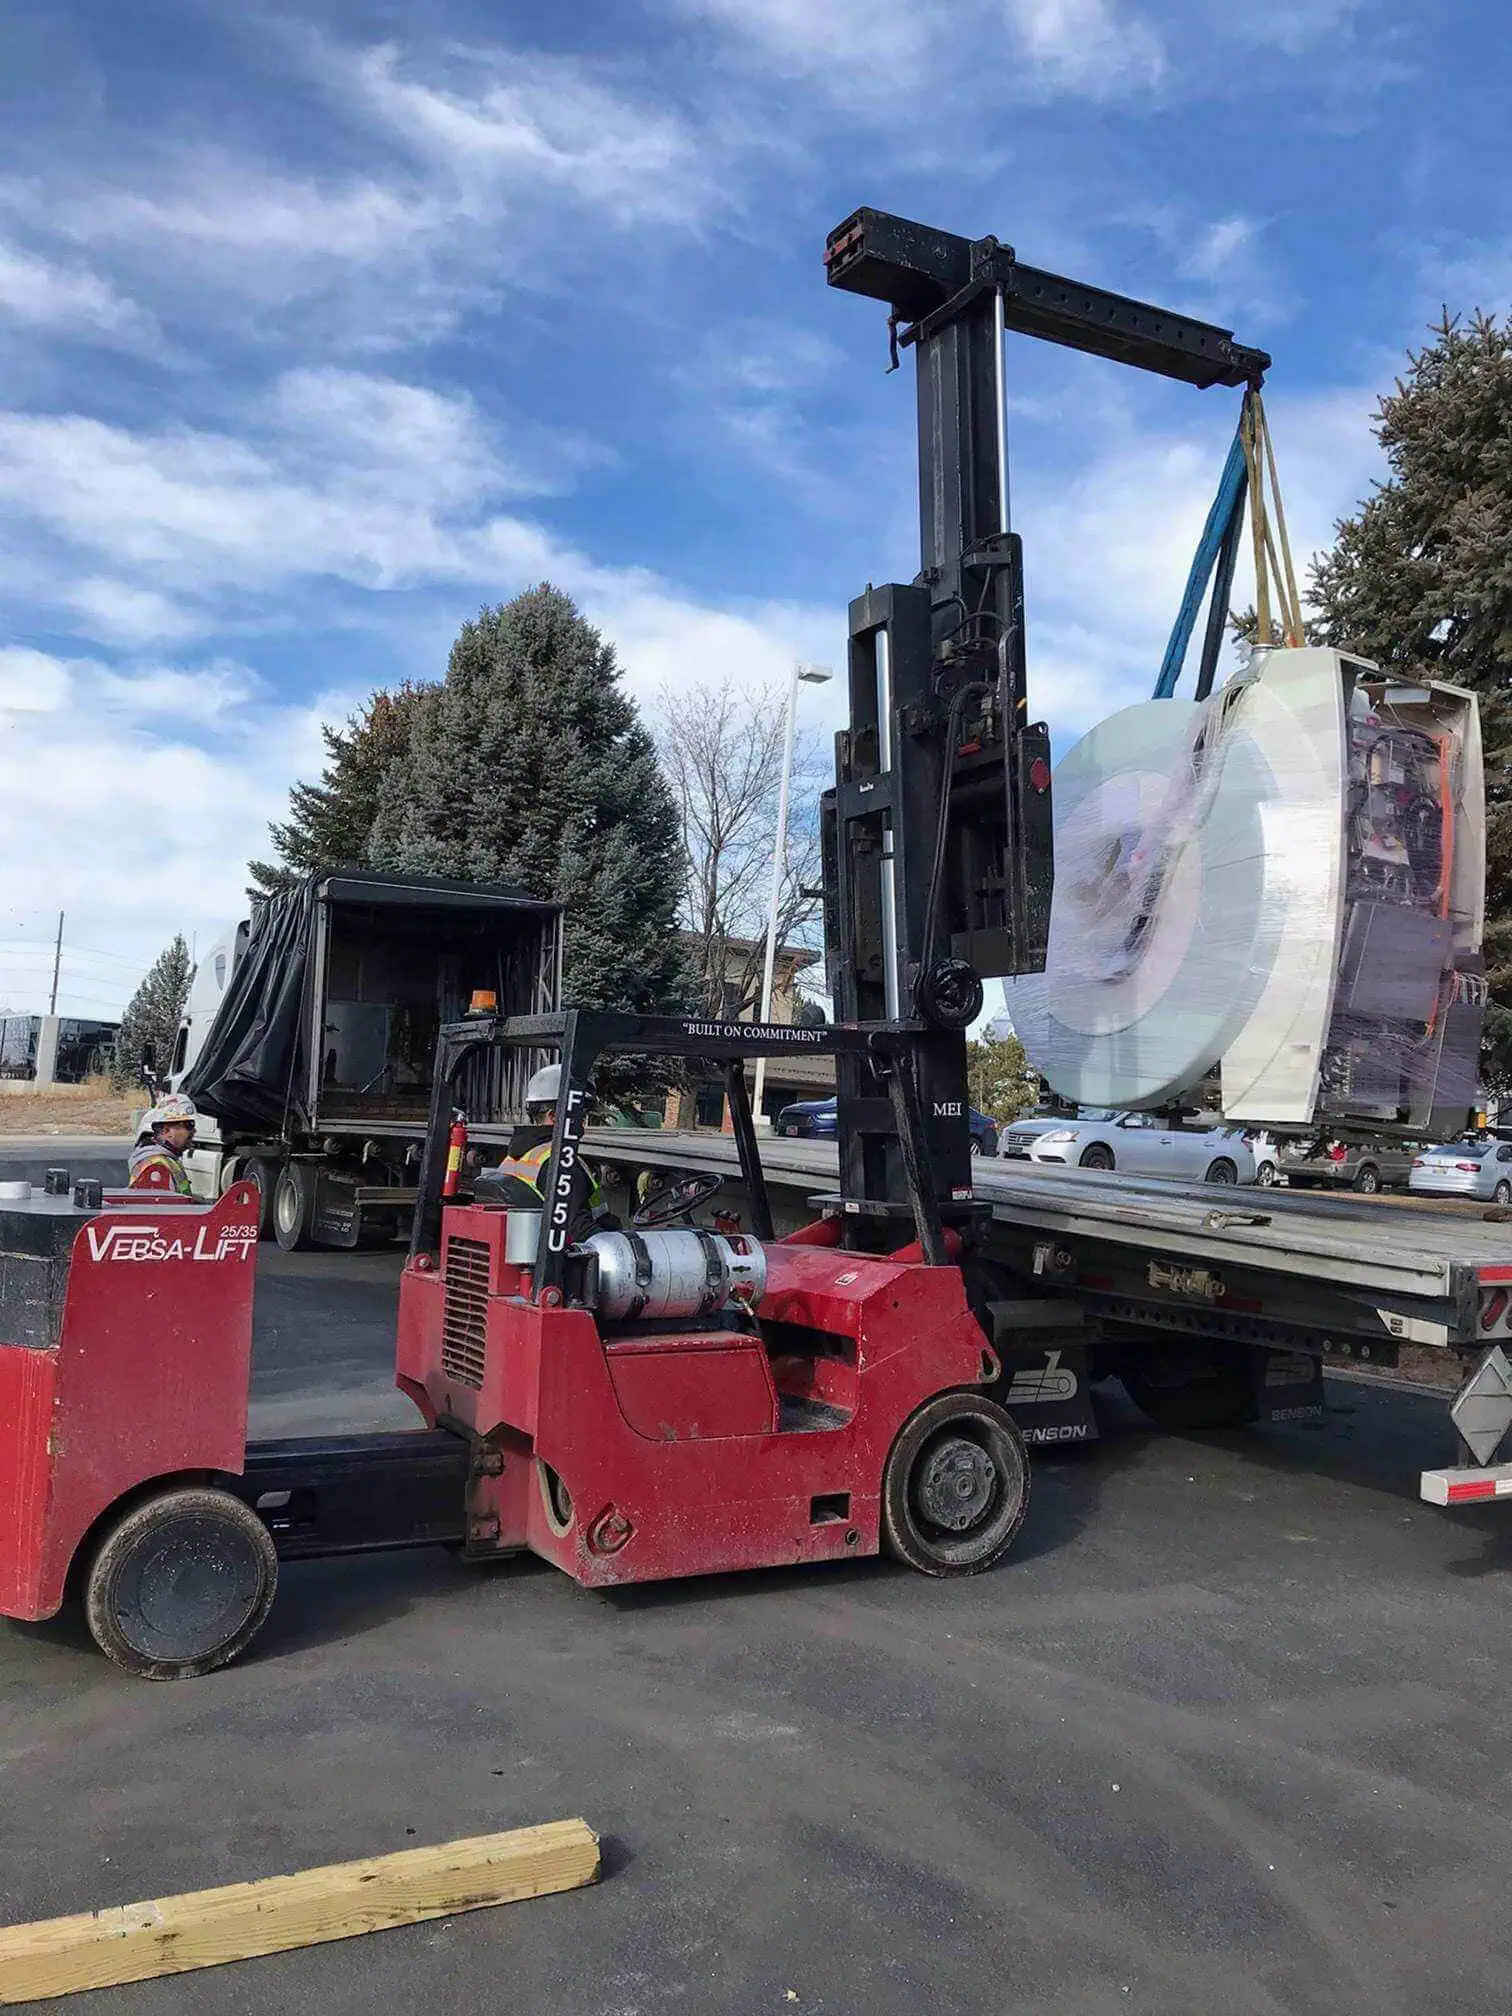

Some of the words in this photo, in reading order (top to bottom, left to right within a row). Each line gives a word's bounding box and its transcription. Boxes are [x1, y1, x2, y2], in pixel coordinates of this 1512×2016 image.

[724, 1025, 741, 1037] ON
[933, 1102, 962, 1116] MEI
[548, 1090, 583, 1252] FL355U
[220, 1225, 257, 1238] 25/35
[87, 1226, 257, 1261] VERSA-LIFT
[1021, 1424, 1087, 1442] ENSON
